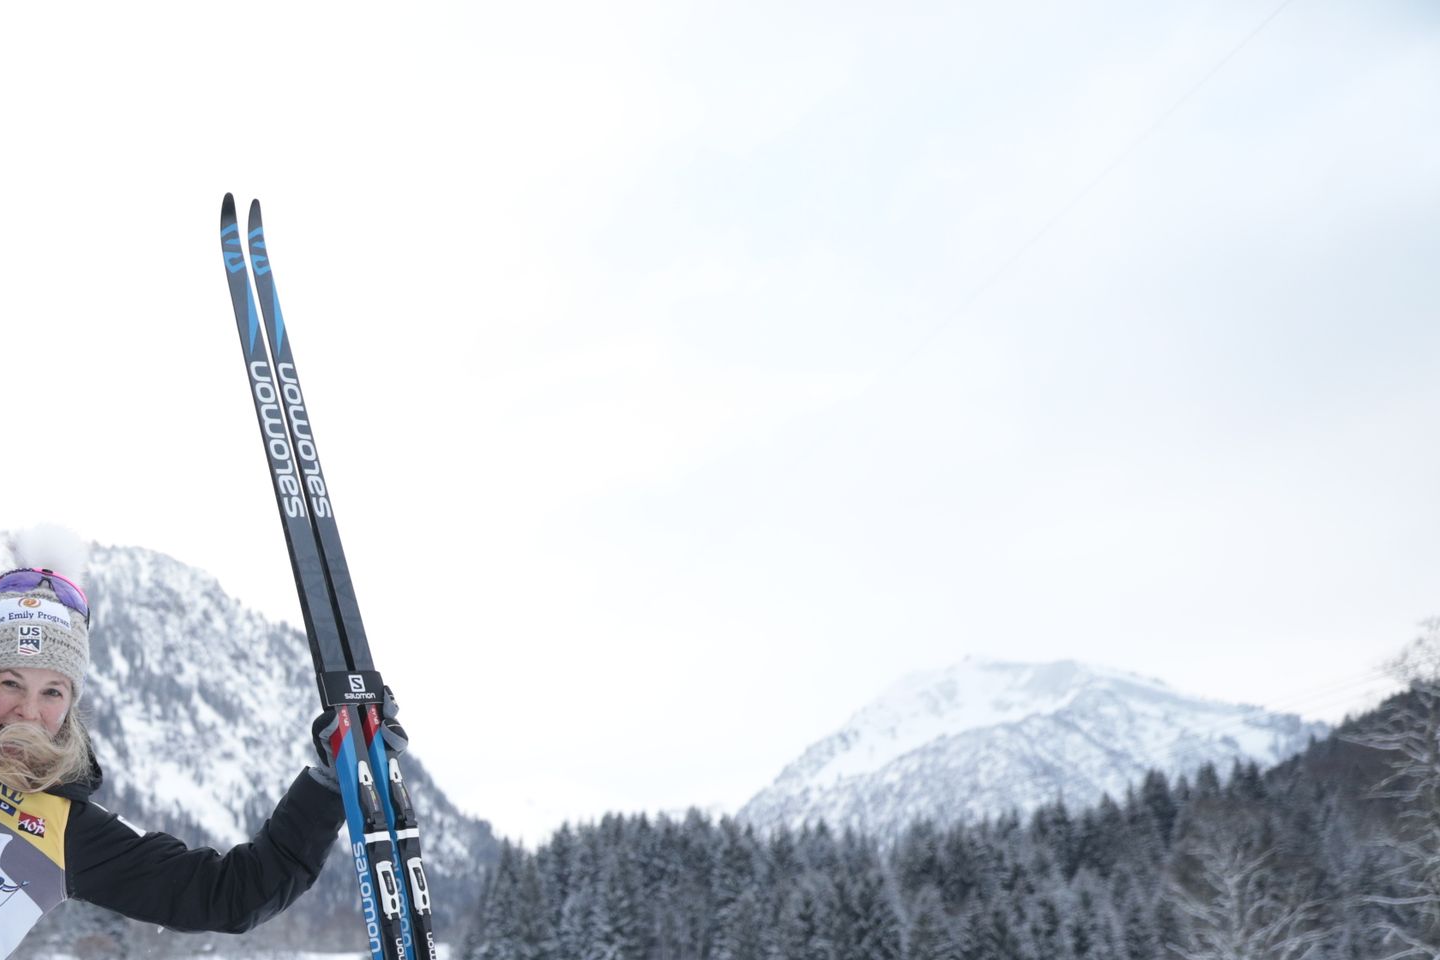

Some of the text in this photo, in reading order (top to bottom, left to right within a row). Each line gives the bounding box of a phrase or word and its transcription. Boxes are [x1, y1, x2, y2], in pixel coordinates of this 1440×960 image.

[8, 611, 34, 620] Emily
[20, 627, 40, 636] US
[18, 819, 45, 835] AOP
